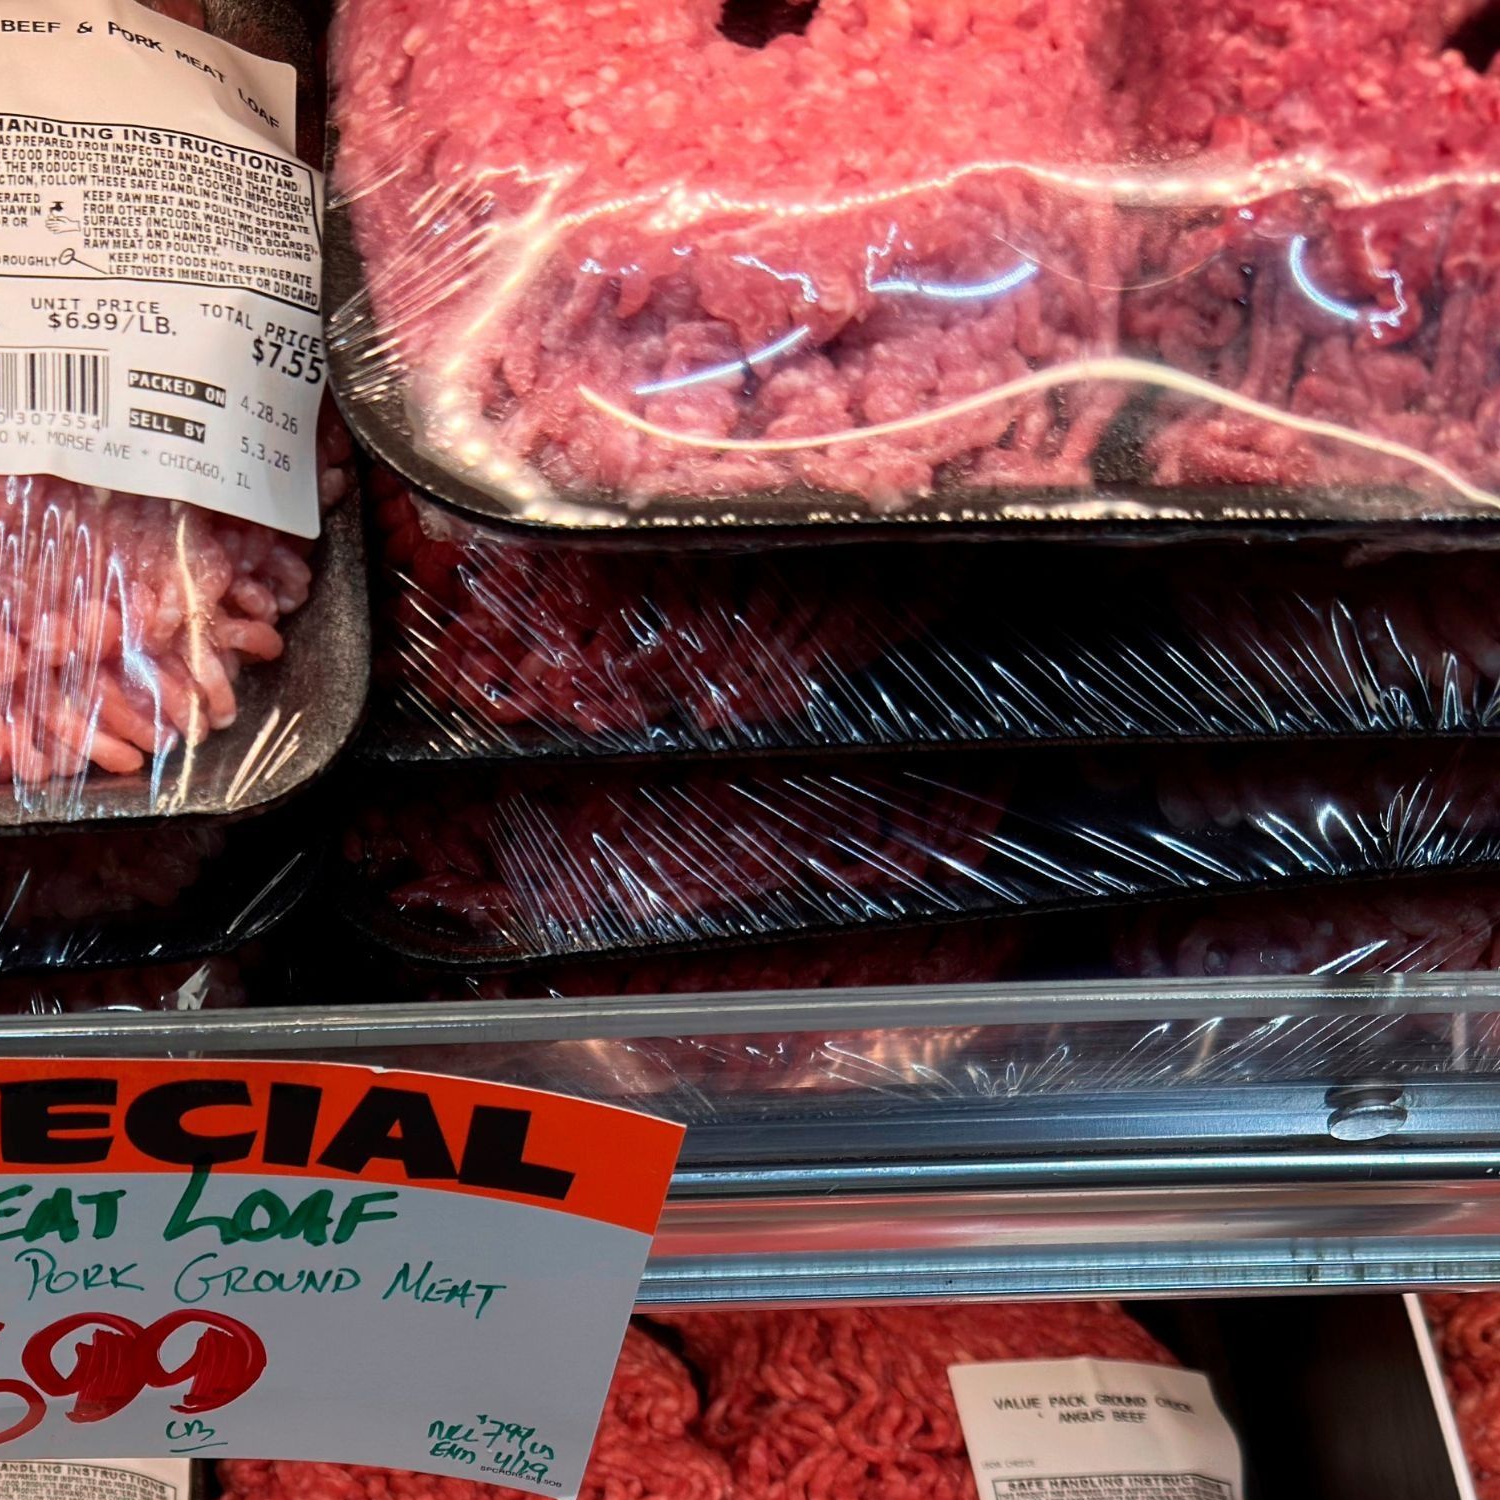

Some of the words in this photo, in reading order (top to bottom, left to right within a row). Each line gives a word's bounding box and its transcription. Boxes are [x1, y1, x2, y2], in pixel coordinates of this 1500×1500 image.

[1, 20, 61, 34] BEEF
[77, 22, 93, 34] &
[108, 21, 164, 52] PORK
[175, 48, 227, 83] MEAT
[237, 88, 280, 128] LOAF
[123, 128, 294, 179] INSTRUCTIONS
[13, 217, 28, 226] OR
[30, 206, 41, 215] IN
[31, 297, 80, 311] UNIT
[98, 299, 160, 315] PRICE
[48, 312, 177, 336] $6.99/LB.
[199, 303, 253, 332] TOTAL
[263, 323, 321, 355] PRICE
[252, 338, 325, 385] $7.55
[129, 372, 196, 398] PACKED
[205, 387, 226, 405] ON
[129, 411, 174, 434] SELL
[183, 421, 205, 441] BY
[240, 395, 299, 434] 4.28.26
[17, 432, 36, 445] W.
[47, 432, 93, 454] MORSE
[103, 444, 131, 459] AVE
[159, 451, 224, 483] CHICAGO,
[236, 472, 252, 489] IL
[240, 437, 291, 472] 5.3.26
[162, 1152, 399, 1247] LOAF
[14, 1253, 145, 1297] PORK
[173, 1253, 362, 1302] GROUND
[382, 1267, 508, 1316] MEAT
